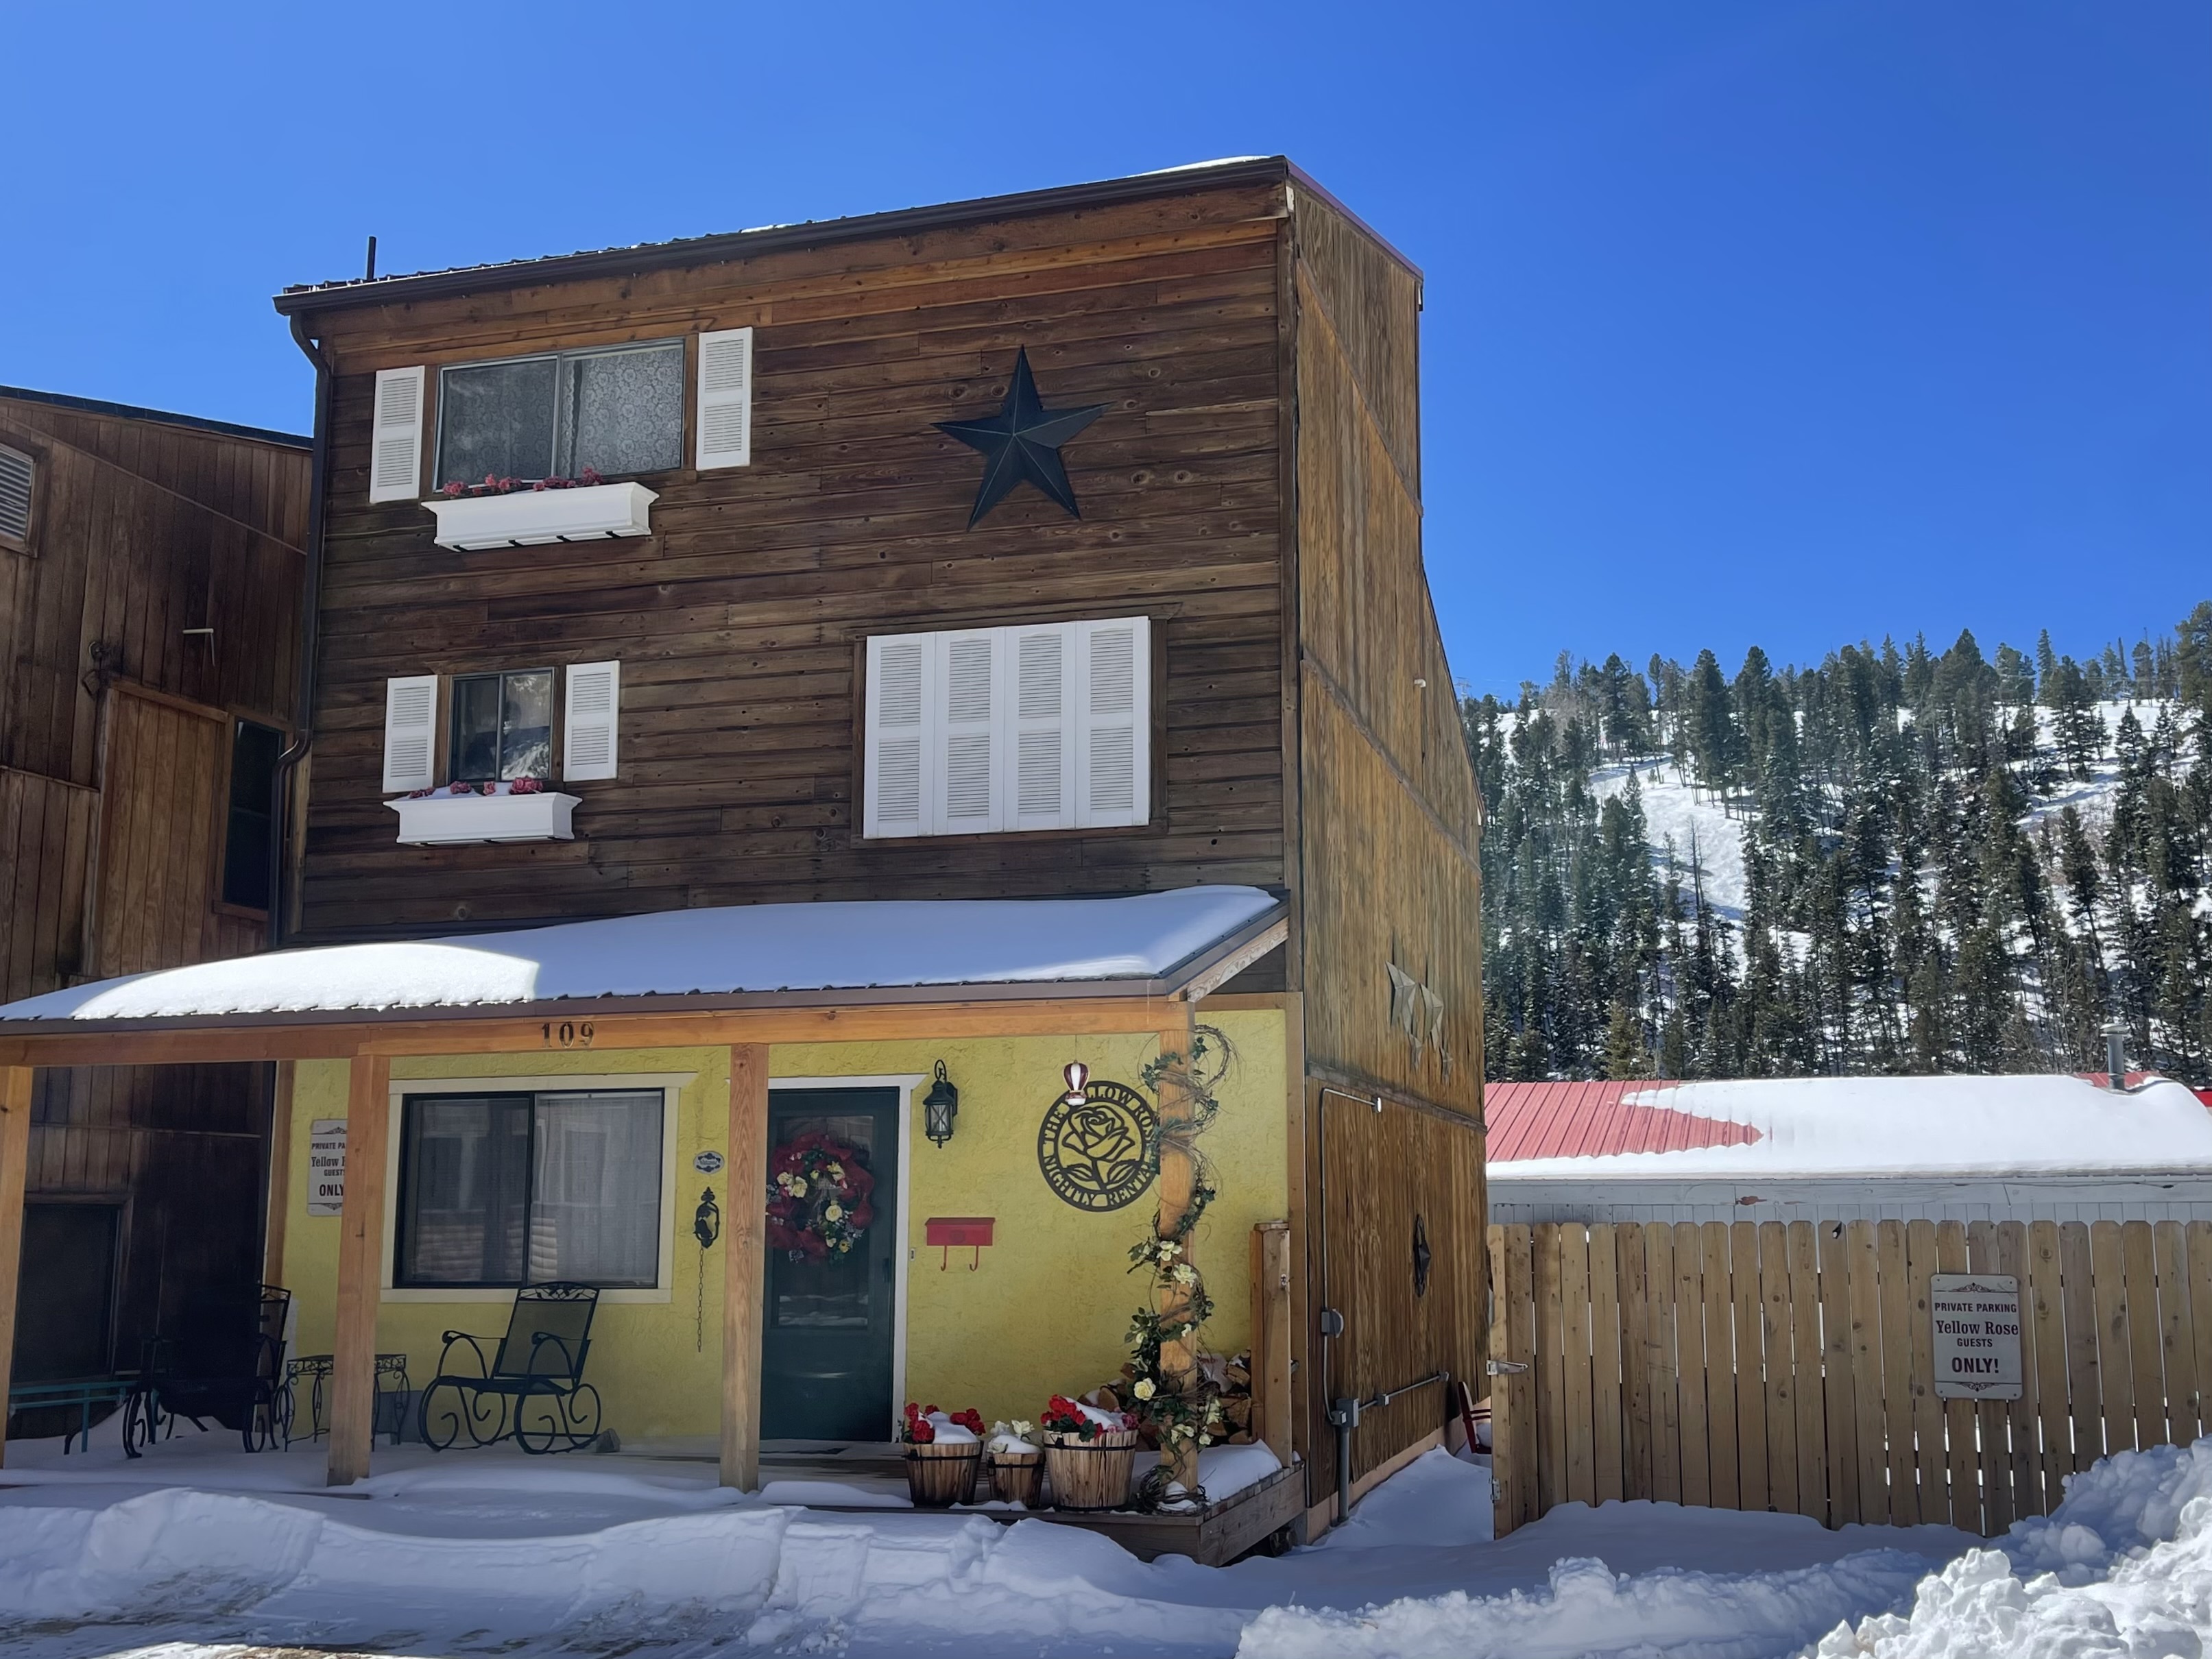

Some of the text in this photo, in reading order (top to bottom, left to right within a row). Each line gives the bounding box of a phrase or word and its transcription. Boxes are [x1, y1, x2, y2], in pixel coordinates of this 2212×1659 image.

[541, 1022, 594, 1048] 109
[1043, 1109, 1064, 1144] THE
[1084, 1085, 1134, 1105] LLOW
[311, 1157, 339, 1167] Yellow
[319, 1184, 344, 1197] ONLY
[1934, 1303, 2017, 1313] PRIVATE PARKING
[1936, 1320, 2019, 1335] Yellow Rose
[1957, 1338, 1993, 1348] GUESTS
[1951, 1357, 1999, 1374] ONLY!
